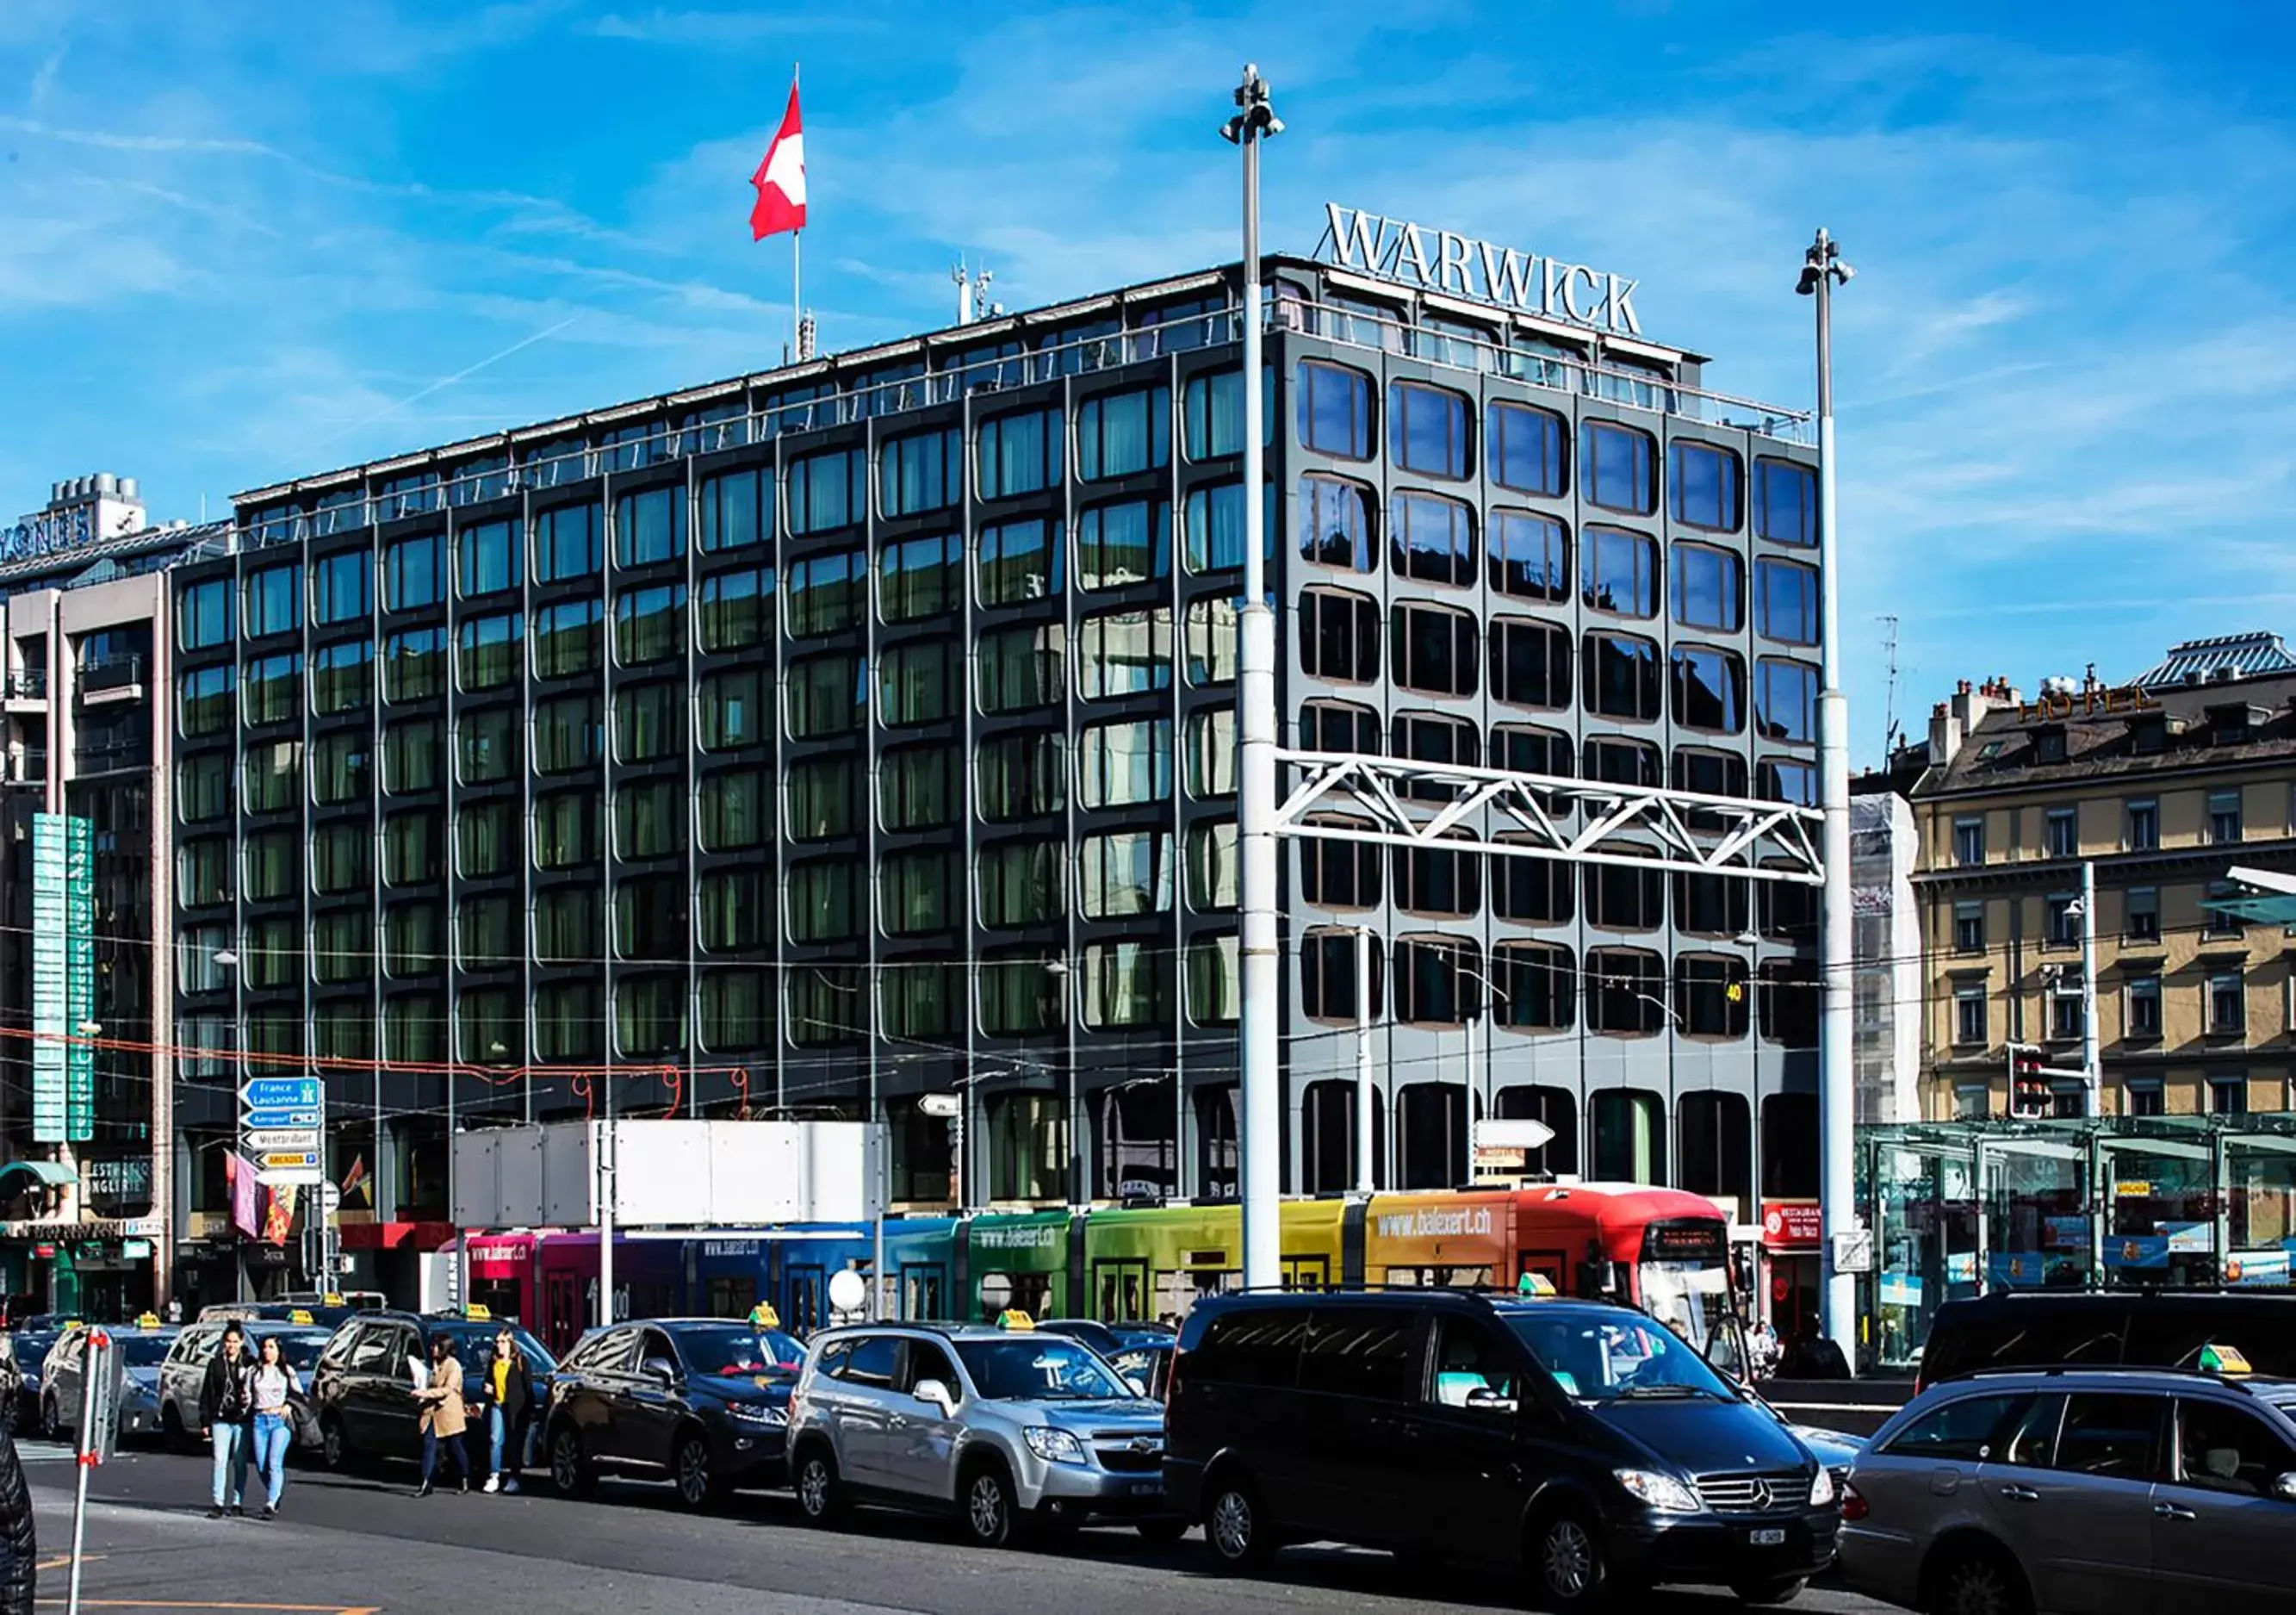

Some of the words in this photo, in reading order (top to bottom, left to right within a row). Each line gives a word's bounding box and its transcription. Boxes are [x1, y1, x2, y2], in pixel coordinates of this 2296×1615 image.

[1325, 202, 1641, 335] WARWICK
[2018, 686, 2163, 722] HOTEL
[260, 1083, 293, 1092] France
[254, 1095, 300, 1105] Lausanne
